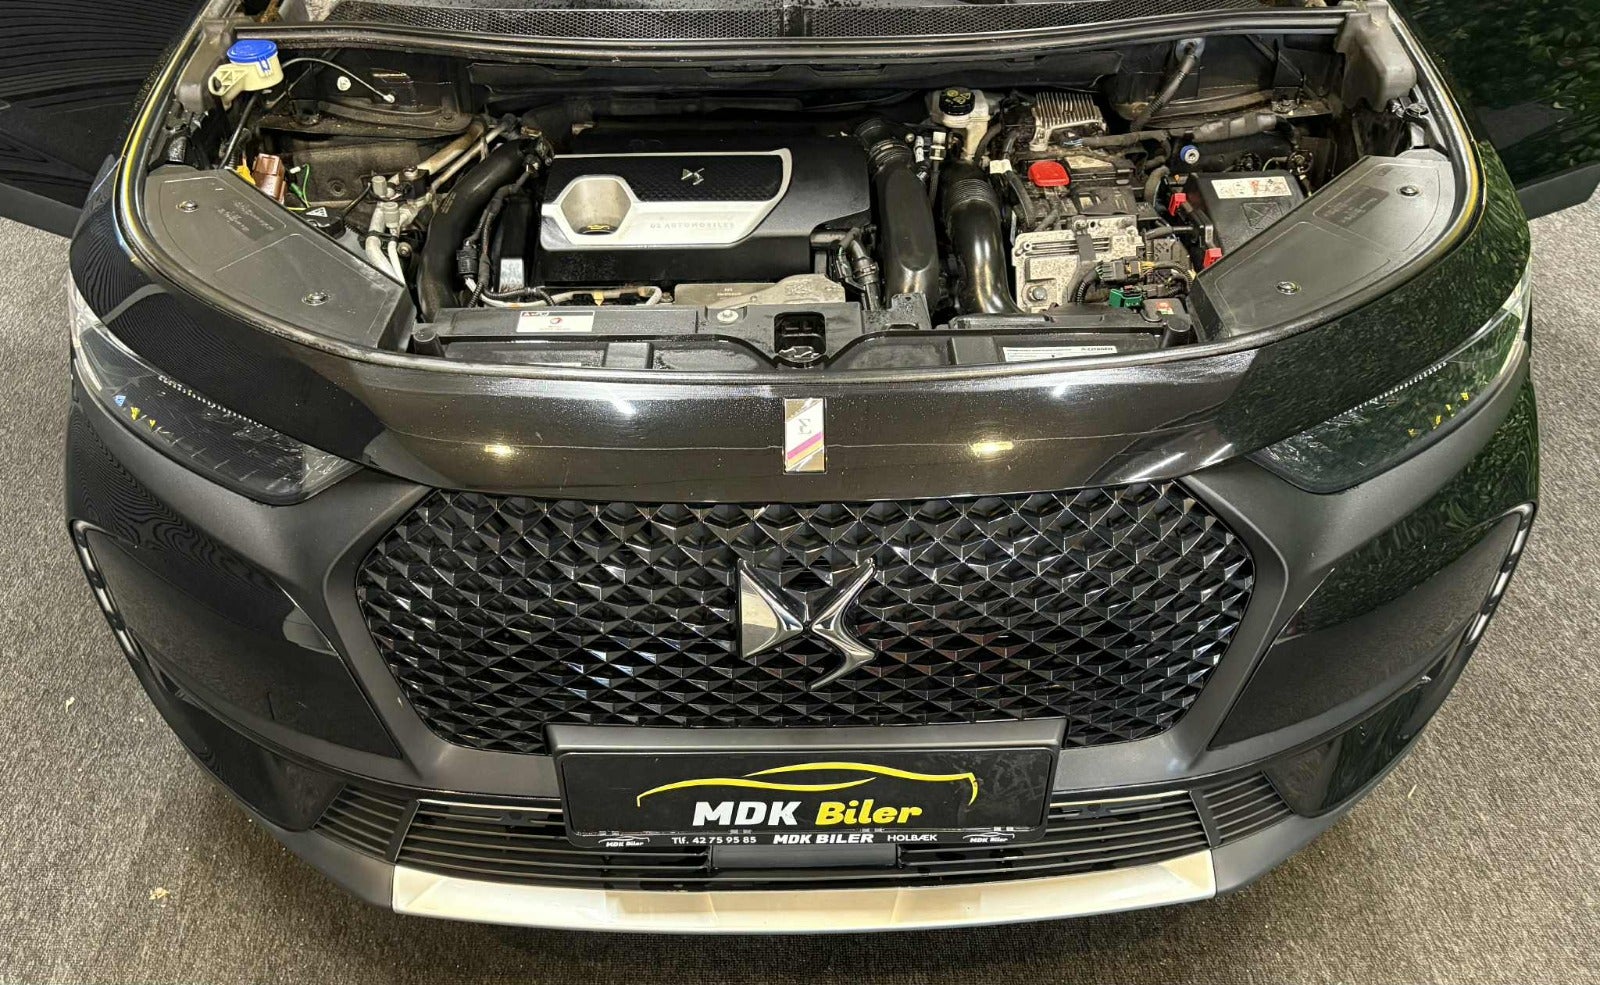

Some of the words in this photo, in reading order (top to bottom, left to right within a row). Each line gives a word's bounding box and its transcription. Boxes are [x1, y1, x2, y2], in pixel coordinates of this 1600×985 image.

[692, 800, 803, 827] MDK
[815, 799, 923, 826] Biler
[671, 836, 689, 845] Tlf.
[773, 833, 812, 845] MDK
[815, 833, 875, 844] BILER
[887, 834, 938, 842] HOLBÆK
